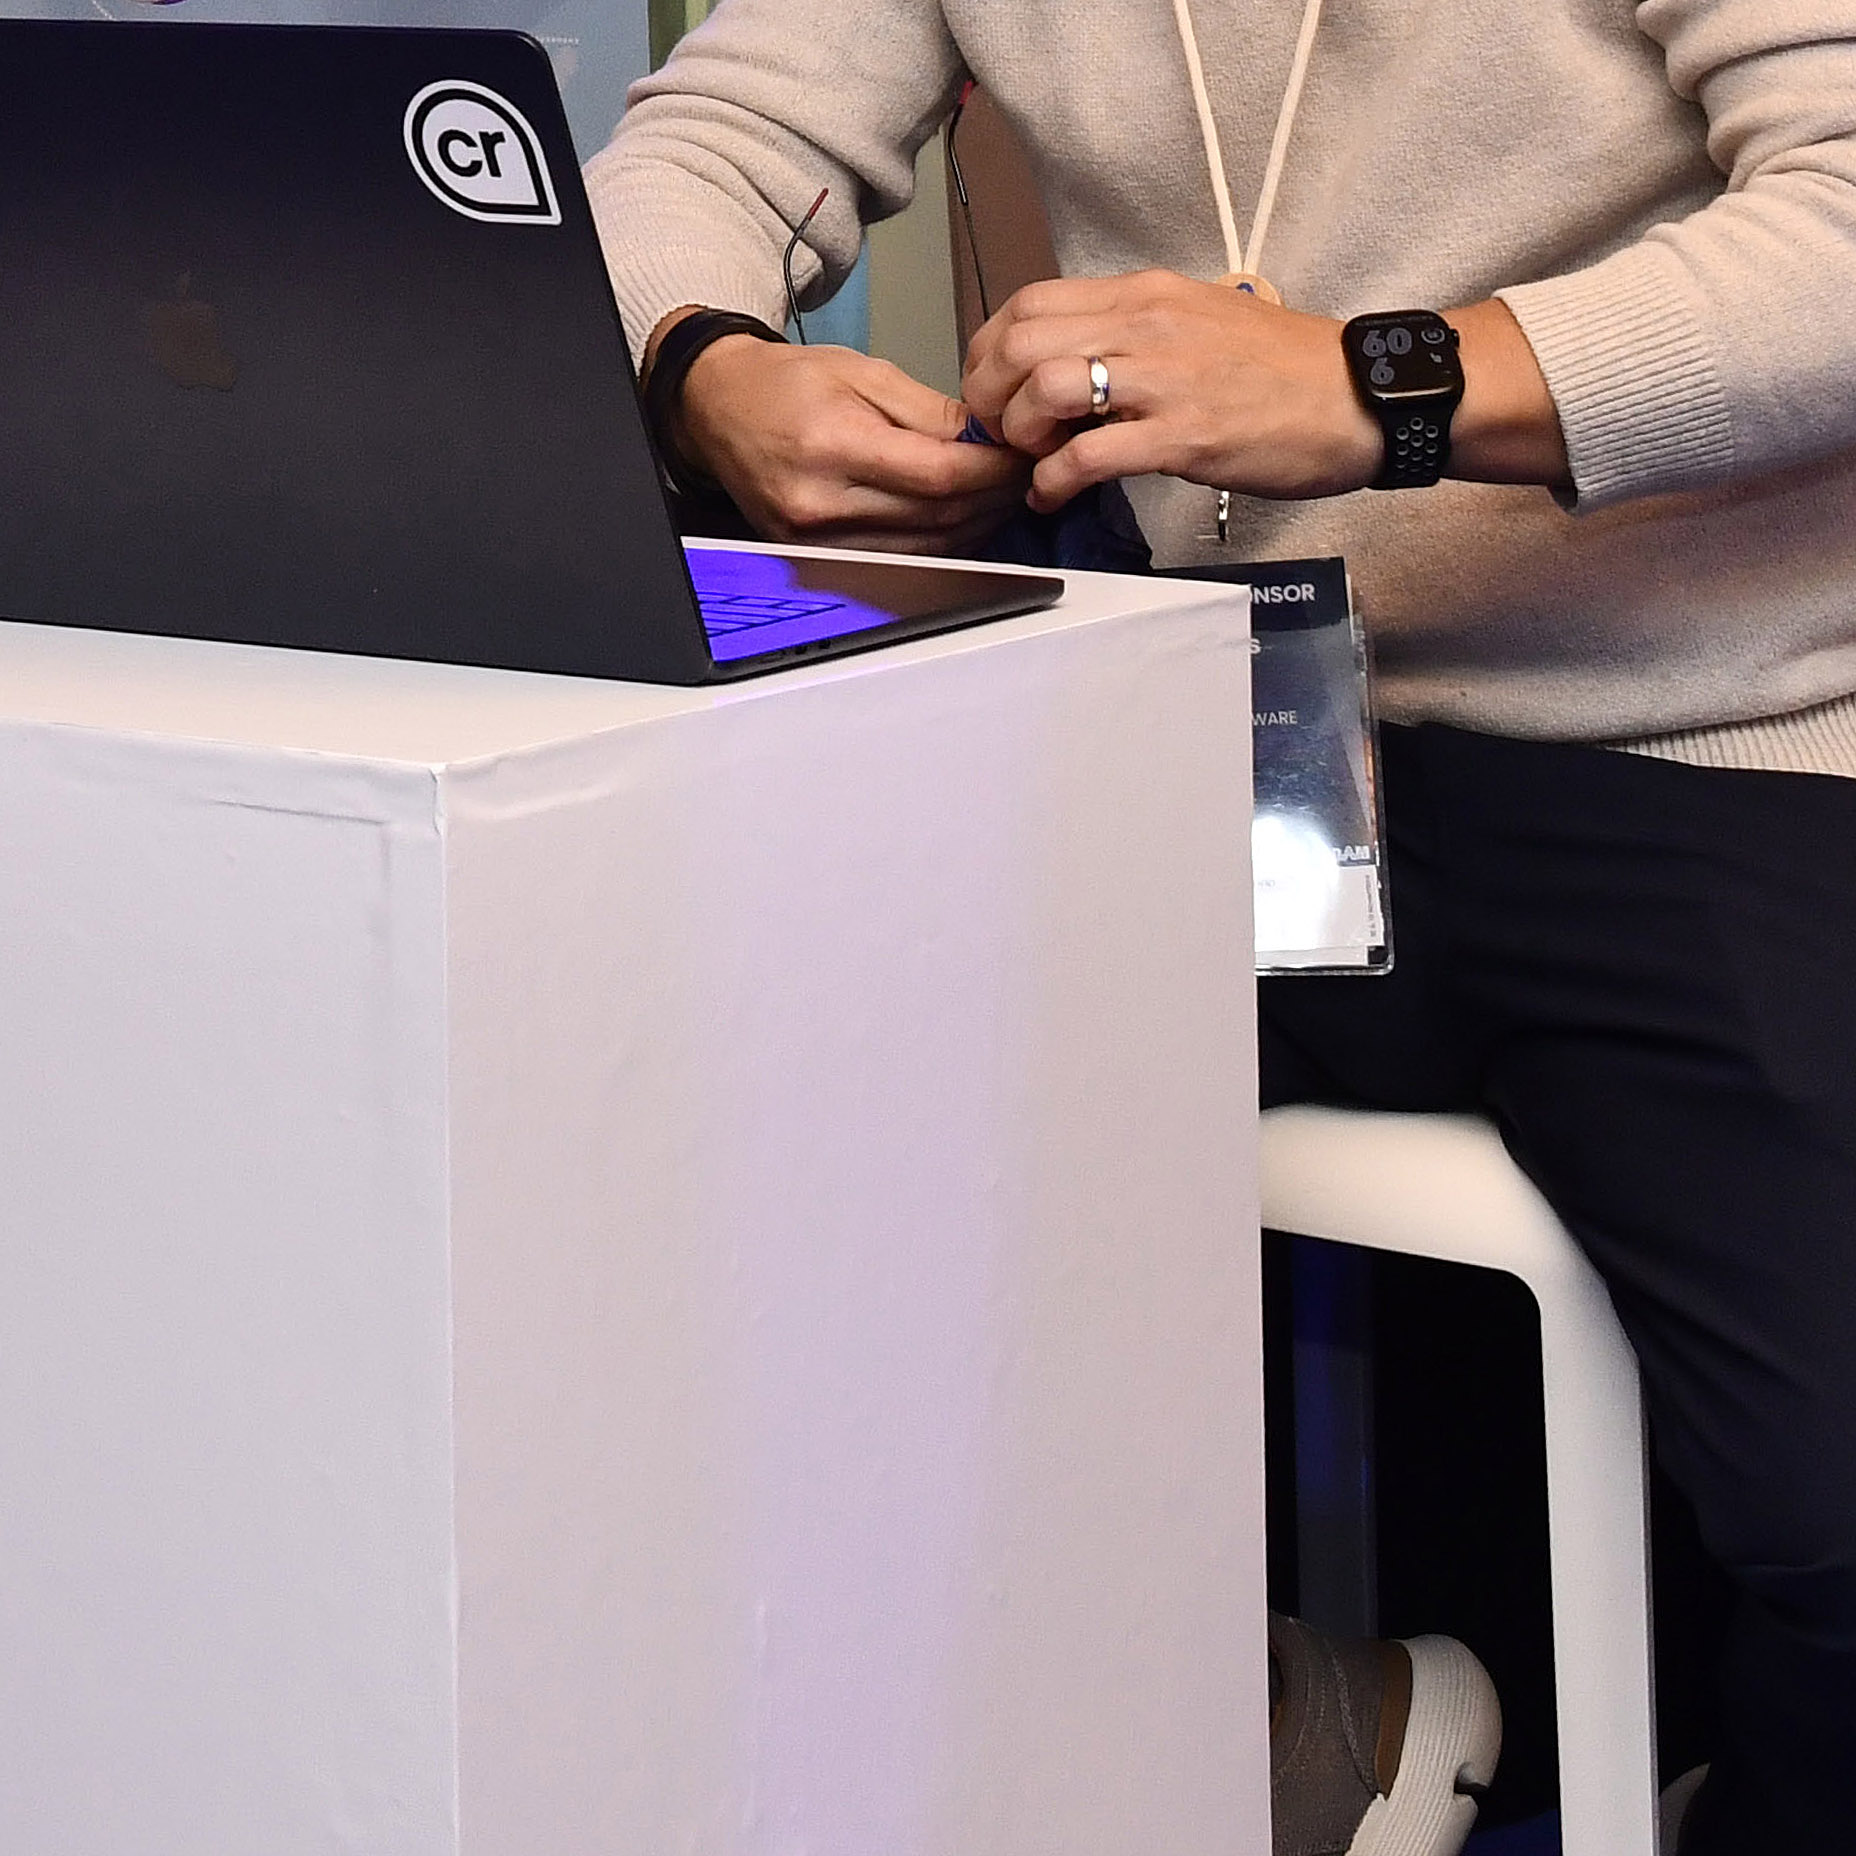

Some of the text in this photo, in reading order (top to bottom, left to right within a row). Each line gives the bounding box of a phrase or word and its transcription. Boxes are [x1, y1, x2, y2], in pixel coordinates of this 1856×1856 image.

[437, 128, 507, 178] cr
[1252, 582, 1316, 605] NSOR
[1252, 709, 1298, 727] WARE
